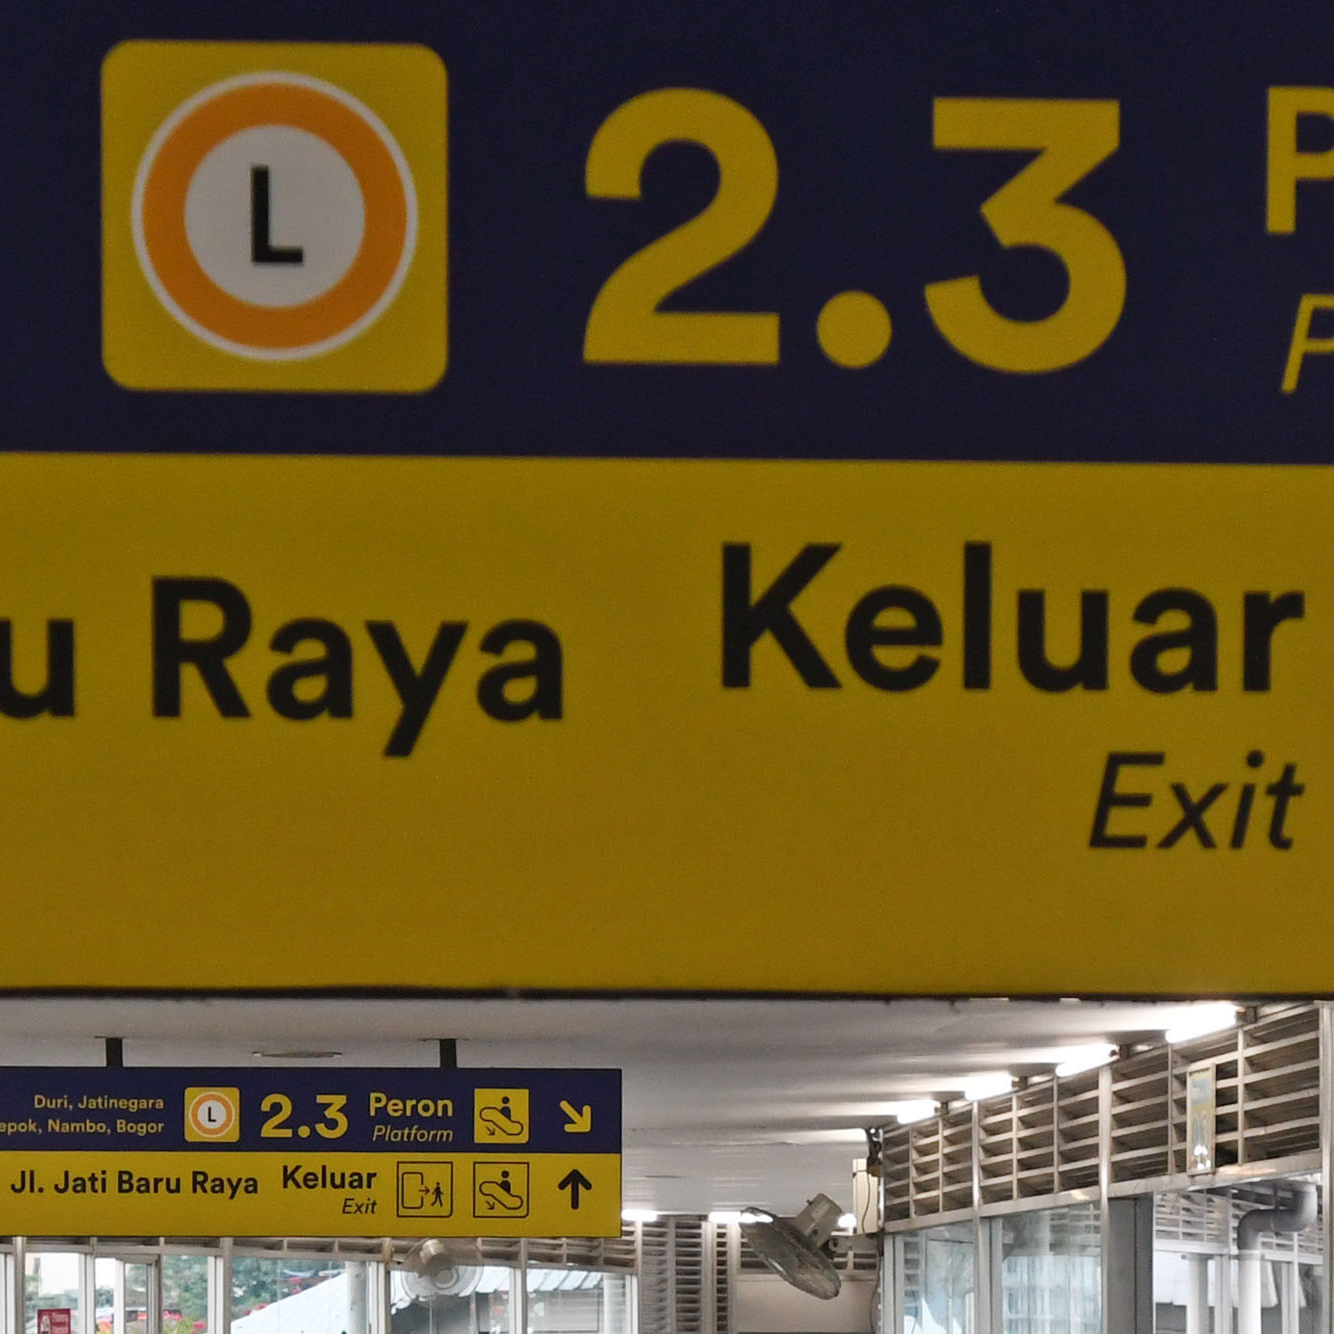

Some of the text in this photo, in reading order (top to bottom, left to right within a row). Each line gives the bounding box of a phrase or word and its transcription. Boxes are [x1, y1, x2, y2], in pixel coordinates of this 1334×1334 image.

[250, 165, 305, 267] L
[582, 88, 1128, 373] 2.3
[720, 539, 1307, 697] Keluar
[151, 574, 565, 760] Raya
[1088, 748, 1307, 852] Exit
[33, 1094, 164, 1113] Duri, Jatinegara
[207, 1106, 217, 1123] L
[260, 1093, 349, 1139] 2.3
[369, 1092, 454, 1118] Peron
[47, 1119, 111, 1135] Nambo,
[116, 1119, 165, 1136] Bogor
[372, 1124, 454, 1144] Platform
[10, 1169, 259, 1200] Jl. Jati Baru Raya
[282, 1164, 377, 1190] Keluar
[342, 1197, 377, 1216] Exit
